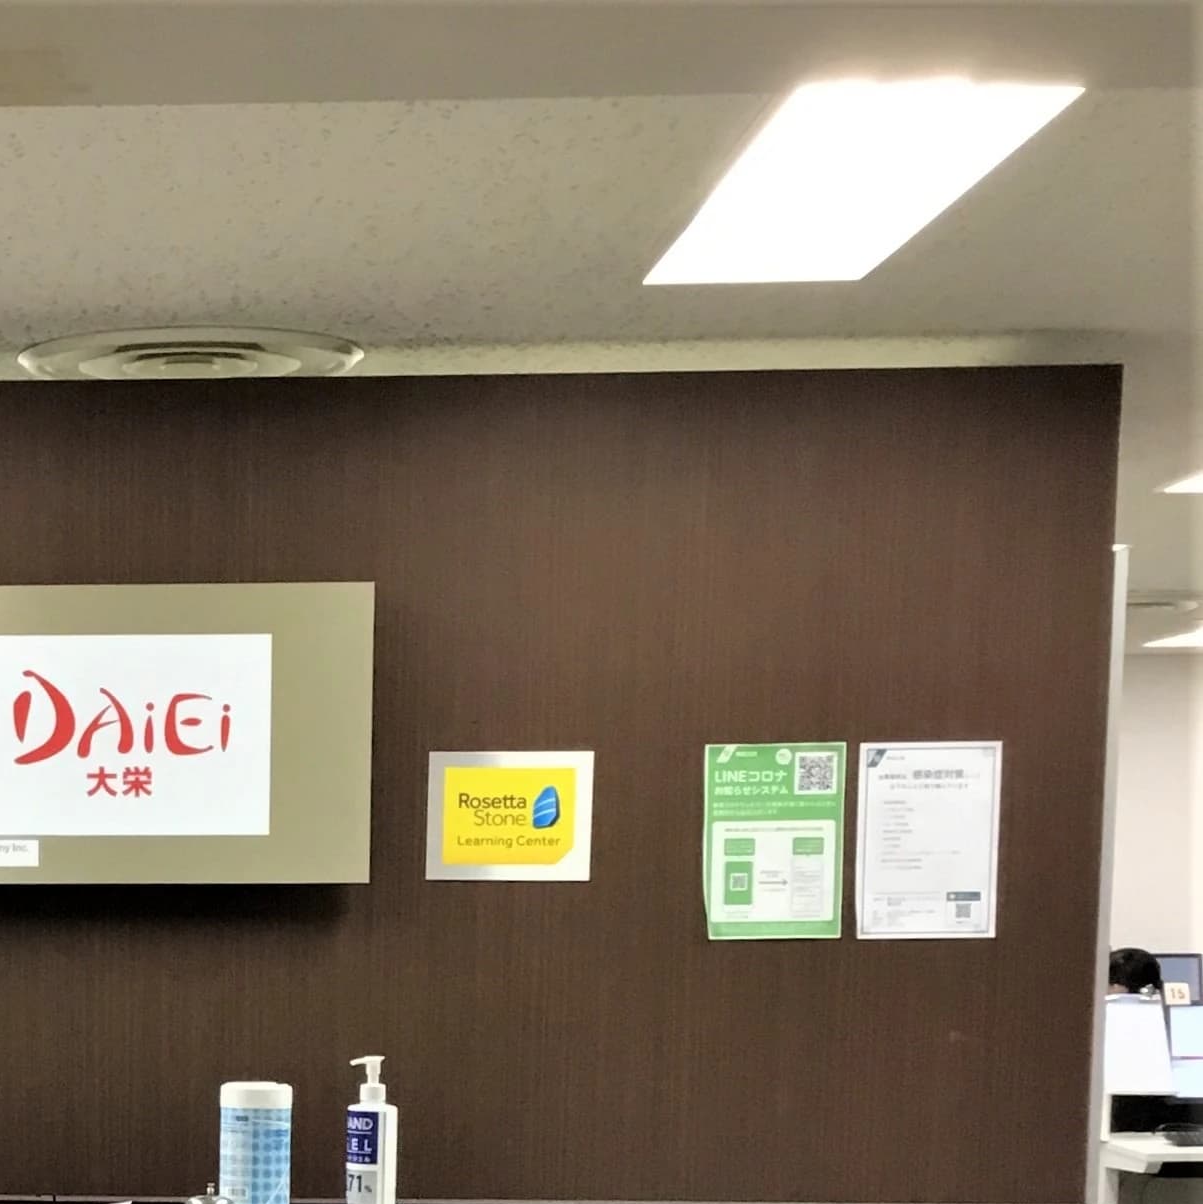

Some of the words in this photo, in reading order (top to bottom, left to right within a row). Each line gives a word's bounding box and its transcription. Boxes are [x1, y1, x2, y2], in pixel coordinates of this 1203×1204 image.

[86, 766, 153, 799] 大栄
[714, 769, 788, 783] LINEコロナ
[458, 793, 527, 809] Rosetta
[474, 809, 527, 827] Stone
[457, 835, 513, 848] Learning
[516, 836, 561, 846] Center
